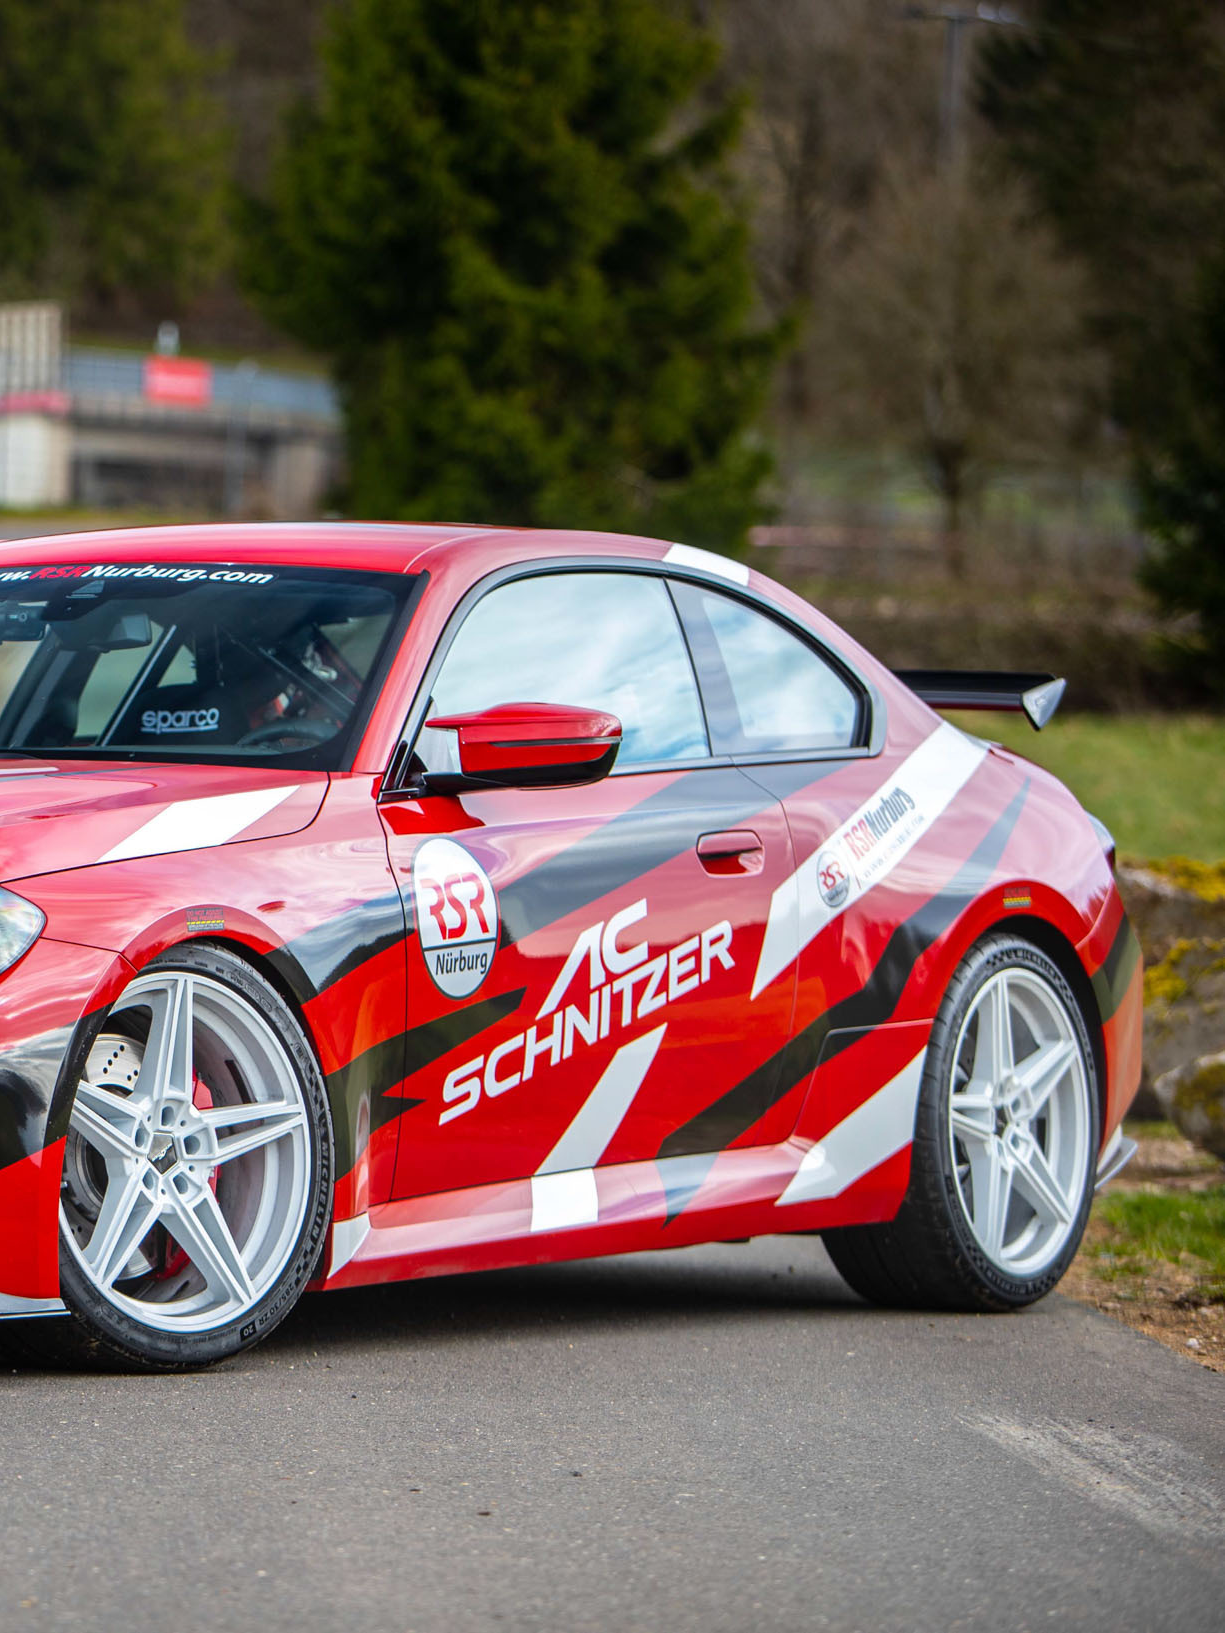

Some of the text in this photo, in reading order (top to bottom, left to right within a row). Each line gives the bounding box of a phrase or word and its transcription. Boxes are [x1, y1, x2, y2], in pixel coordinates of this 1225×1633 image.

[141, 707, 220, 734] sparco
[419, 871, 490, 940] RSR
[434, 950, 488, 977] Nürburg
[535, 897, 648, 1021] AC
[438, 920, 736, 1126] SCHNITZER
[311, 1141, 330, 1238] MICHELIN
[243, 1325, 254, 1336] 20
